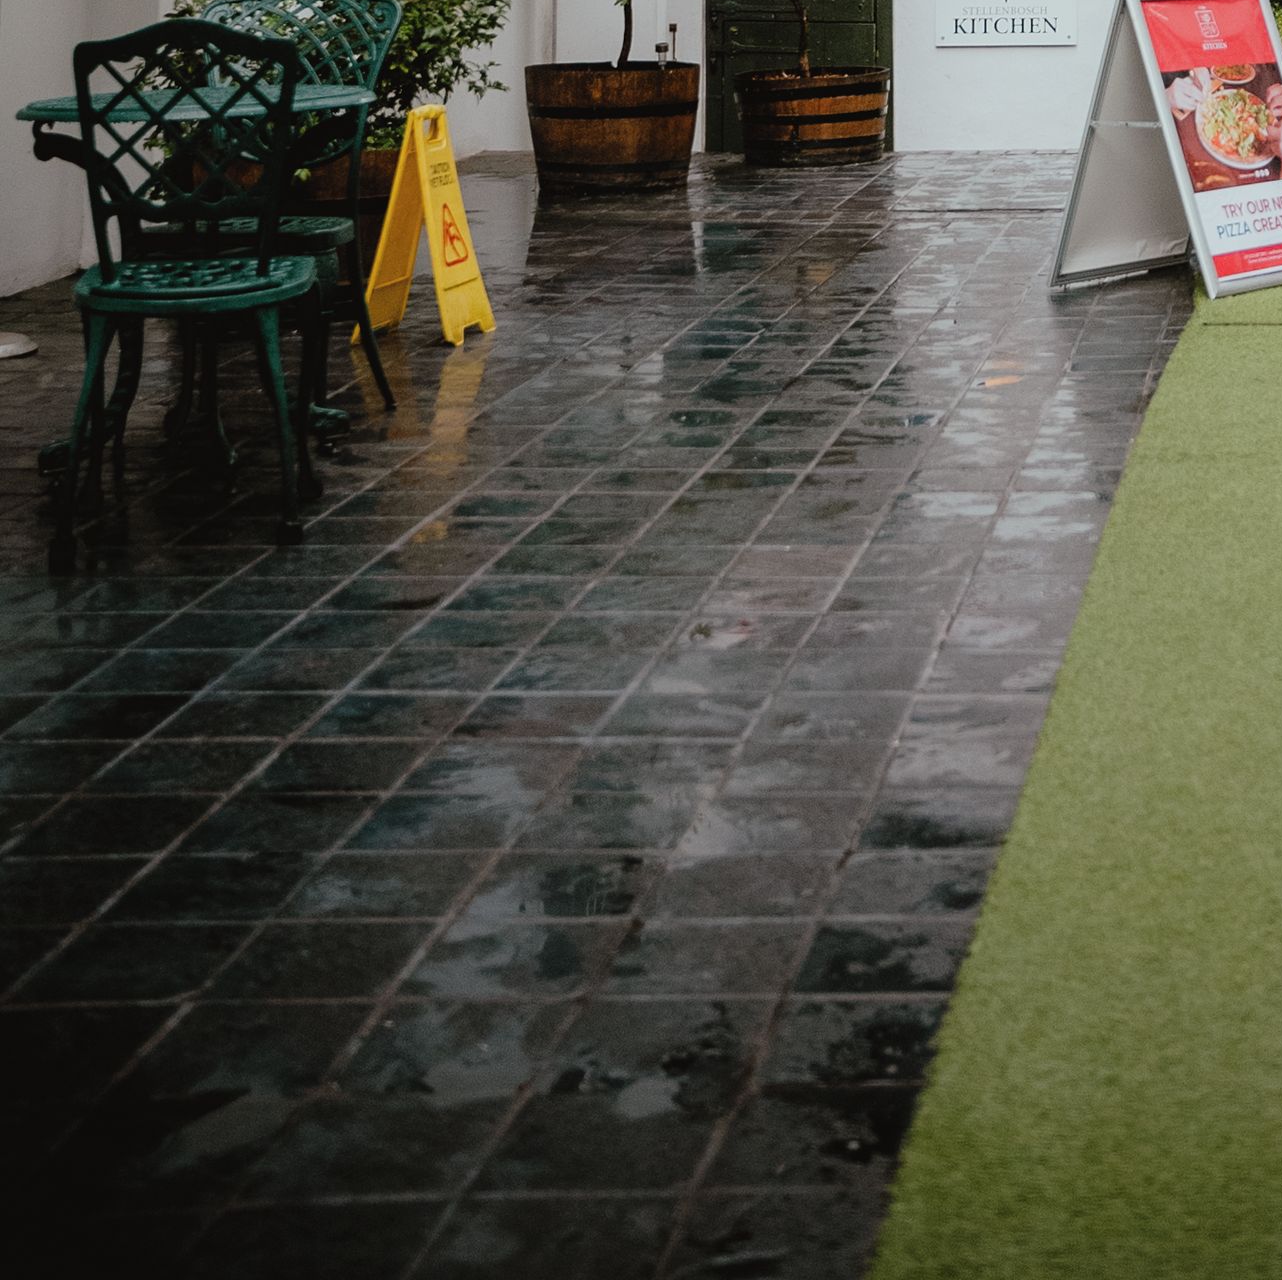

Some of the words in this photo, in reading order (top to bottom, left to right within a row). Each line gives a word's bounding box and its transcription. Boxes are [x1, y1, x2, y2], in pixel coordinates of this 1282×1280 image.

[962, 6, 1048, 15] STELLENBOSCH
[954, 17, 1058, 34] KITCHEN
[1222, 203, 1244, 218] TRY
[1247, 199, 1273, 214] OUR
[1217, 222, 1251, 238] PIZZA
